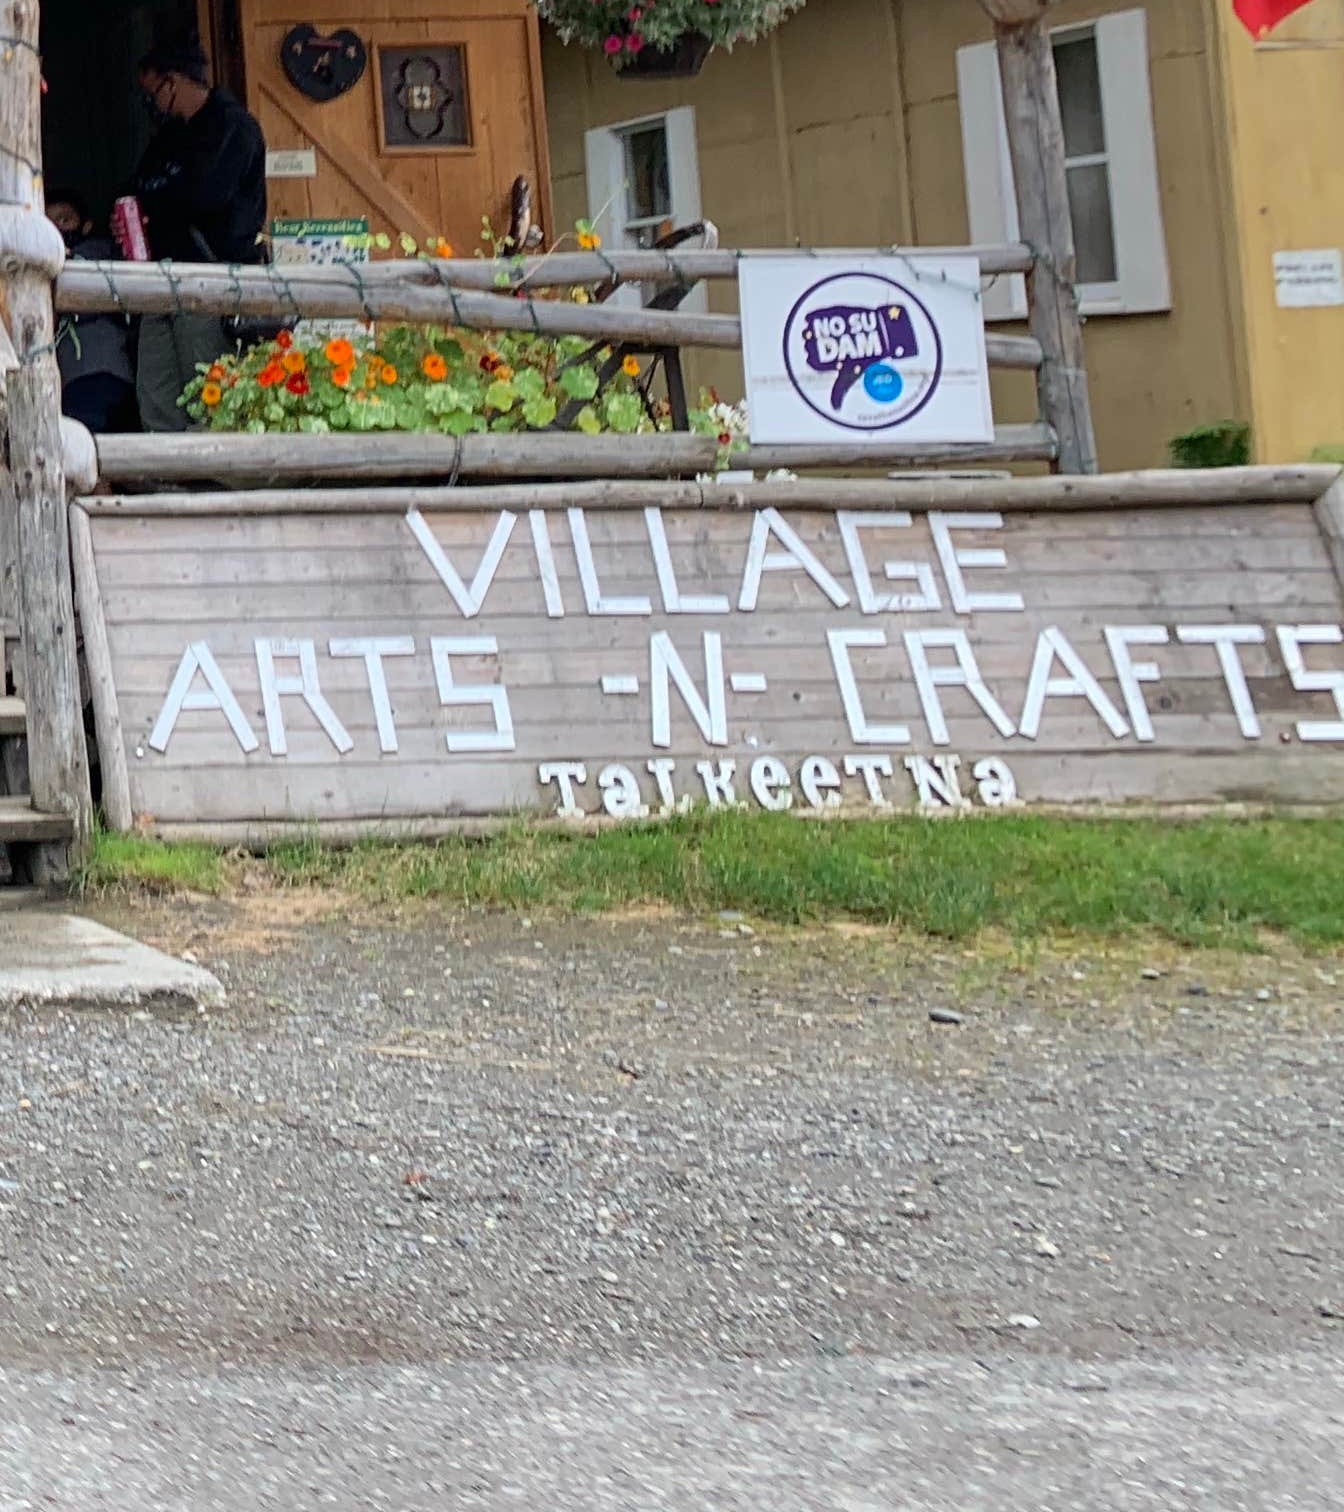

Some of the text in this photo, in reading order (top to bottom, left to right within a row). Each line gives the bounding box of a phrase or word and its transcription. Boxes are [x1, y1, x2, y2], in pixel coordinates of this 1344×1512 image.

[813, 311, 878, 337] NO SU
[818, 331, 883, 363] DAM
[406, 507, 1024, 618] VILLAGE
[149, 636, 516, 756] ARTS
[826, 624, 1344, 747] CRAFTS
